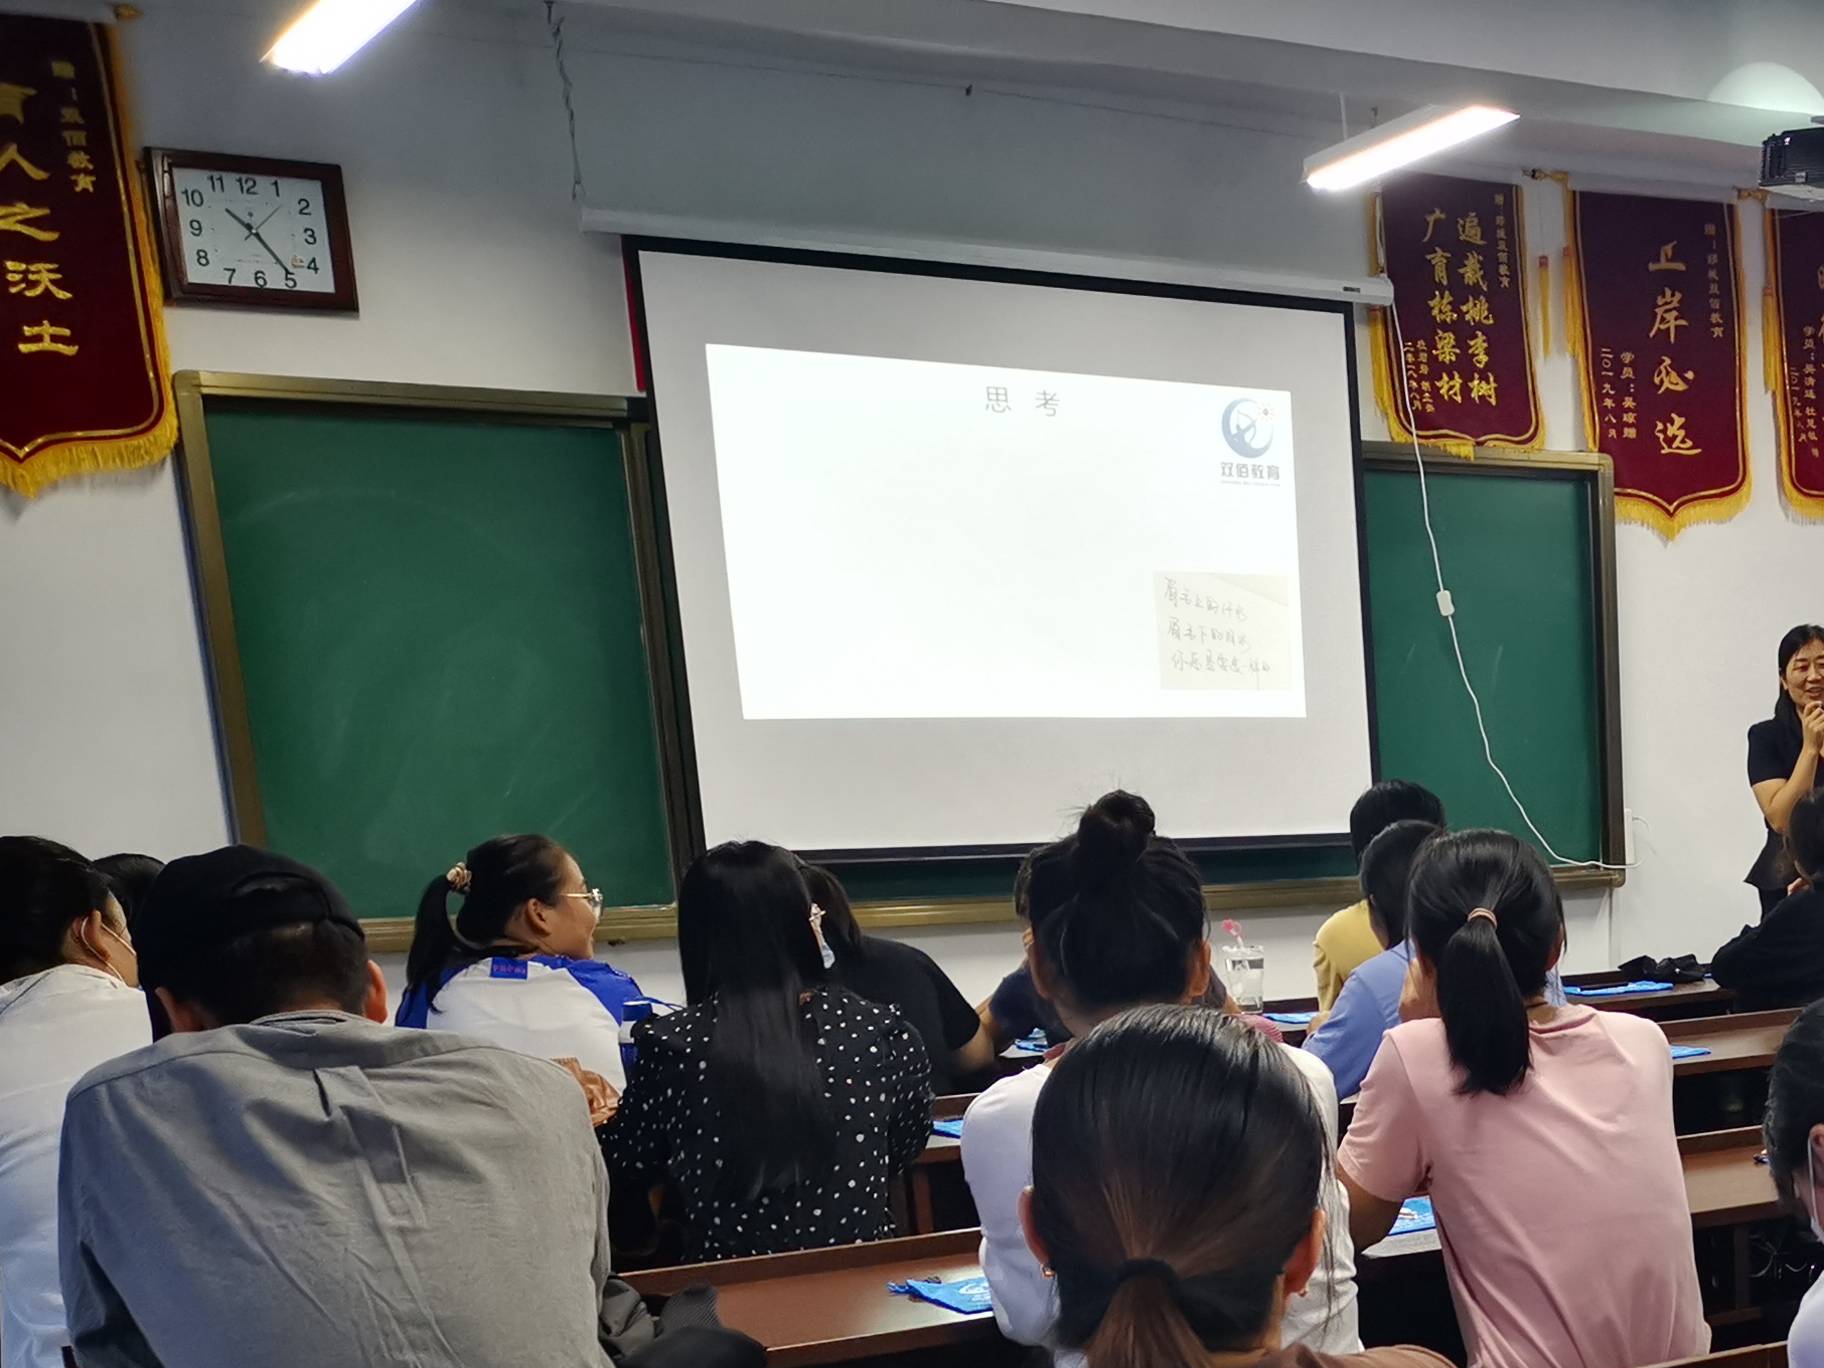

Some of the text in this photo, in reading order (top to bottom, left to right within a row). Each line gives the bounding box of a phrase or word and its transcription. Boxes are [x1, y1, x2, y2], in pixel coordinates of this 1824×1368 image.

[207, 174, 225, 193] 11
[235, 177, 258, 195] 12
[271, 179, 280, 197] 1
[181, 188, 205, 208] 10
[298, 198, 311, 216] 2
[189, 219, 203, 237] 9
[303, 227, 317, 245] 3
[196, 249, 210, 267] 8
[306, 257, 319, 274] 4
[223, 267, 236, 284] 7
[254, 270, 268, 288] 6
[285, 271, 297, 289] 5
[1422, 207, 1463, 404] 广育栋梁材
[1456, 212, 1499, 407] 遍栽桃李树
[1647, 240, 1703, 455] 上岸必选
[1220, 461, 1280, 481] 双佰教育
